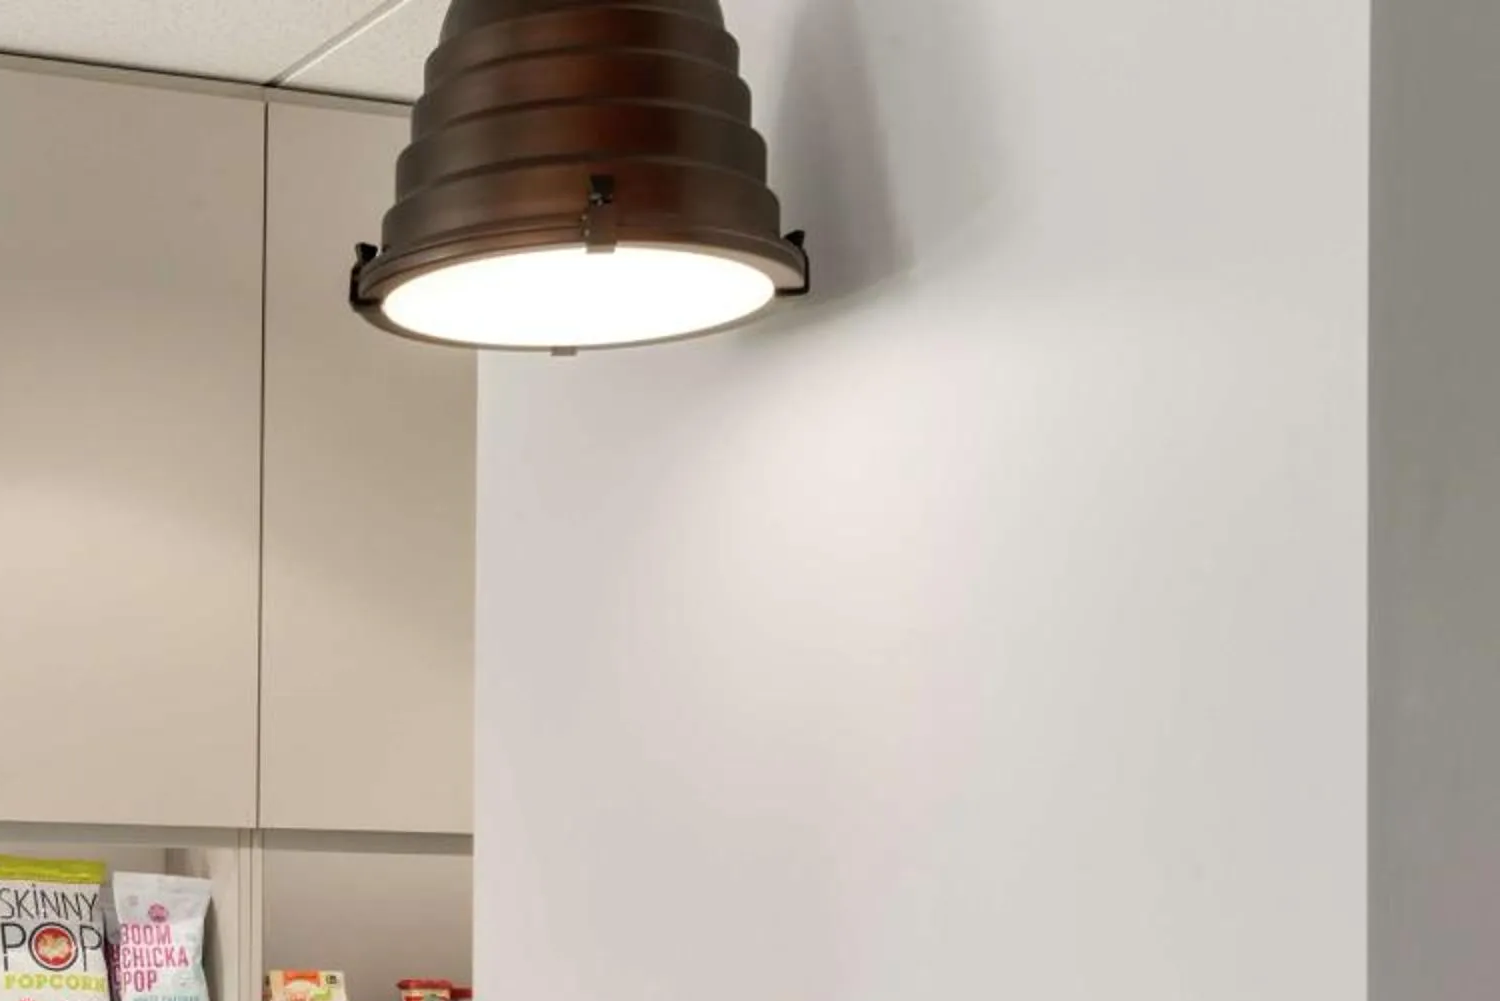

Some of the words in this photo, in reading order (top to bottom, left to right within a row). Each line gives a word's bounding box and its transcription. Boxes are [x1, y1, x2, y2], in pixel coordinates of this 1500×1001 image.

[0, 922, 103, 972] POP
[121, 945, 190, 968] CHICKA
[4, 974, 106, 993] POPCORN
[123, 970, 158, 994] POP
